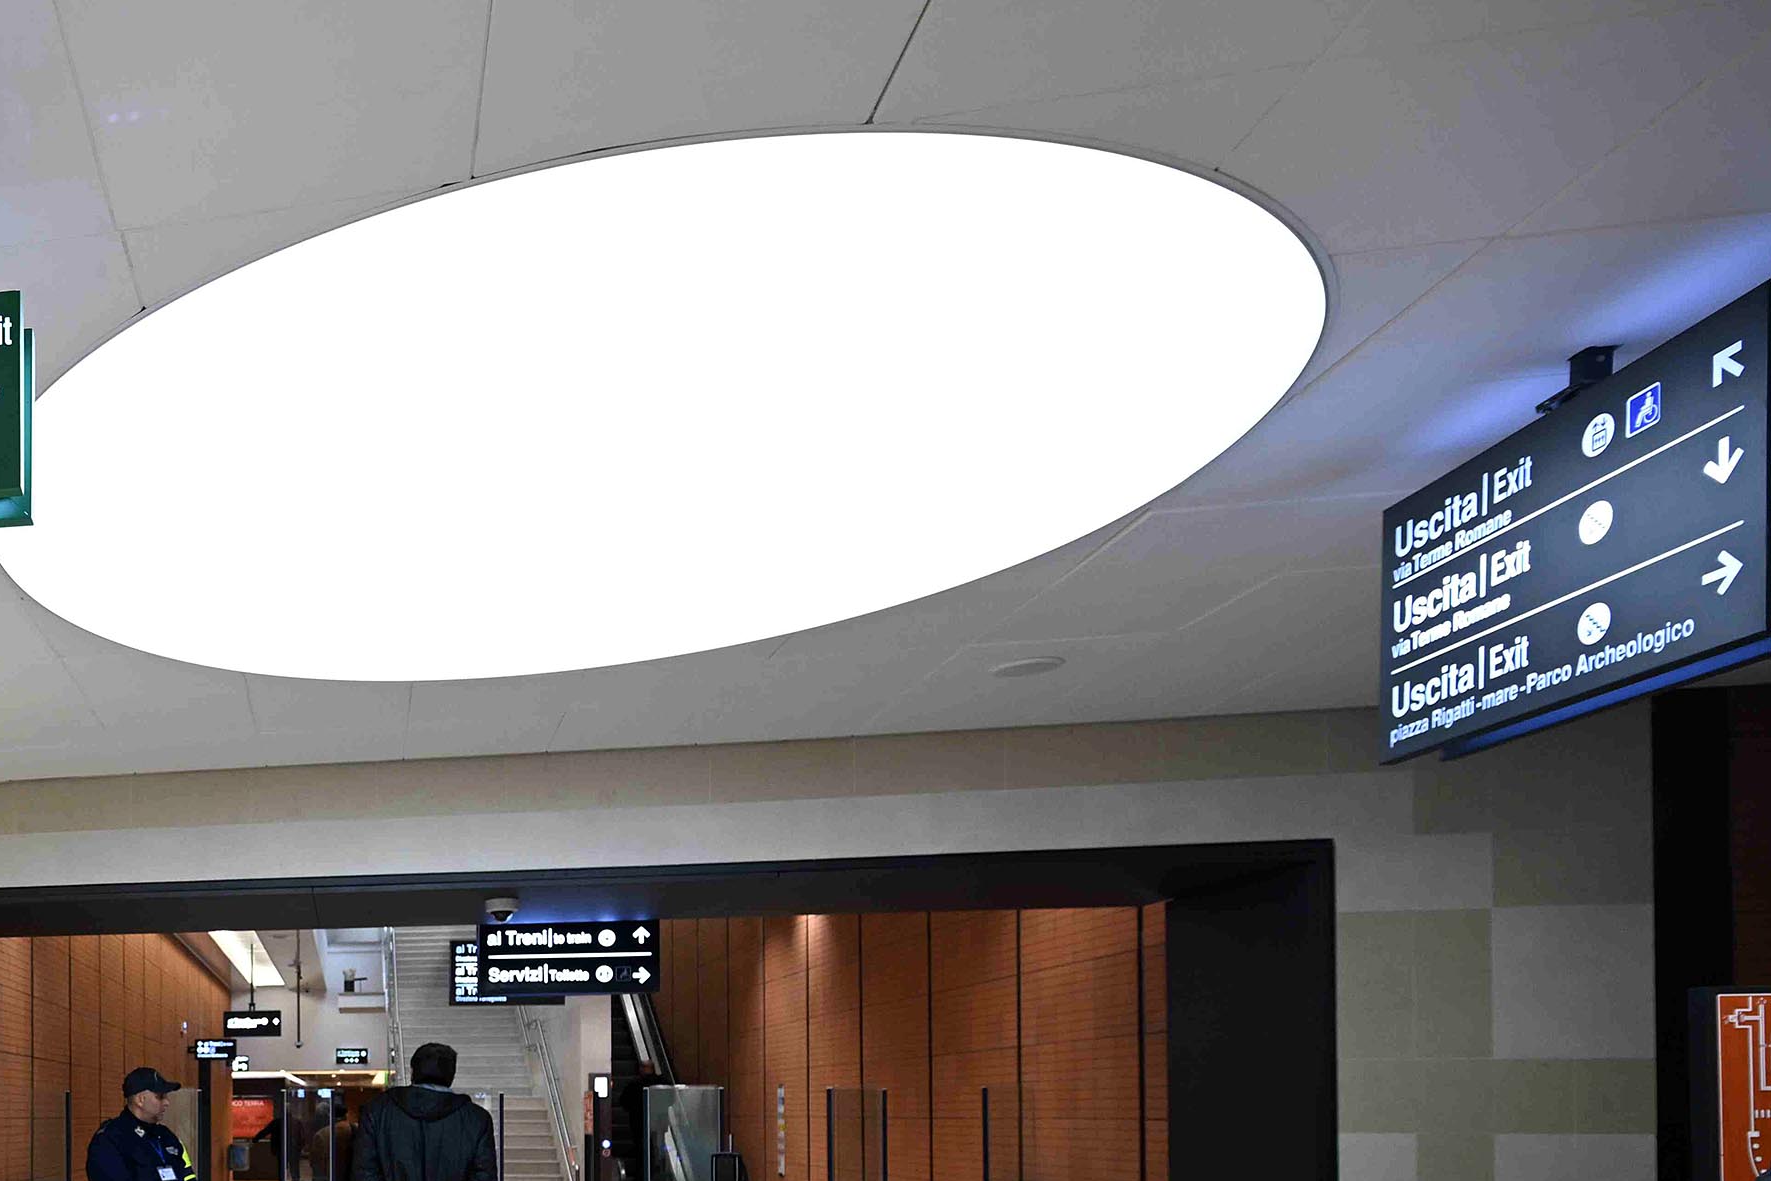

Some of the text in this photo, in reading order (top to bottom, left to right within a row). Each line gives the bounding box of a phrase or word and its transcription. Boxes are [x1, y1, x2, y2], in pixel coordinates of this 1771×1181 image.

[1392, 509, 1512, 582] via Terme Romane
[1395, 456, 1533, 558] Uscita Exit
[1393, 540, 1531, 633] Uscita Exit
[1389, 717, 1429, 748] piazza
[1575, 618, 1695, 677] Archeologico
[1391, 638, 1411, 659] via
[1391, 635, 1529, 718] Uscita Exit
[488, 966, 543, 983] Servizi
[505, 929, 548, 946] Treni
